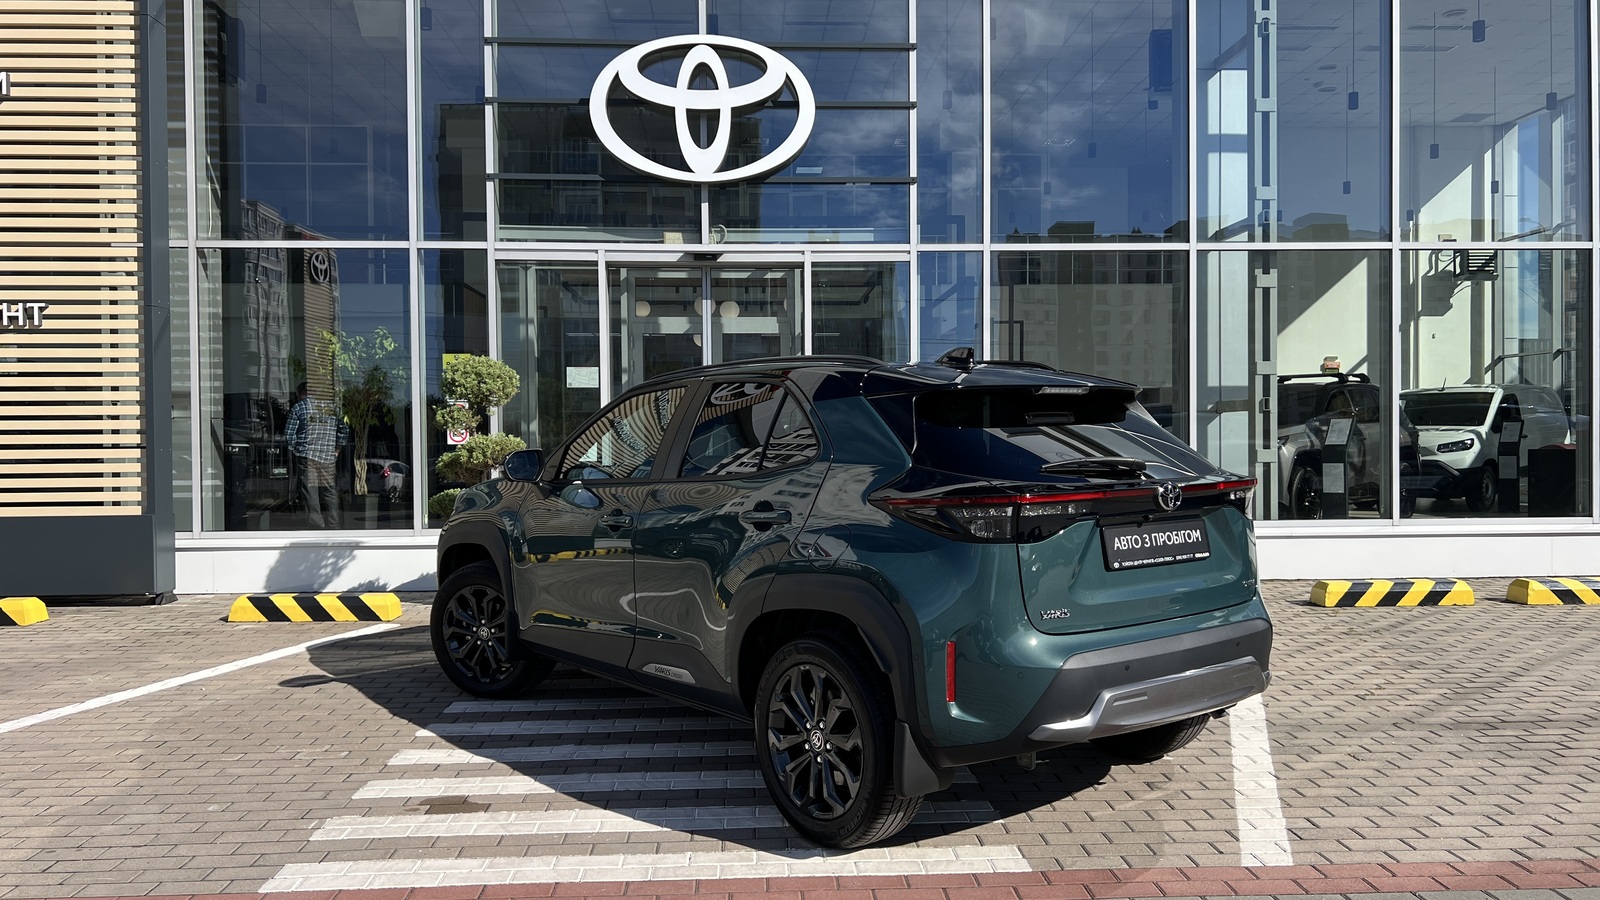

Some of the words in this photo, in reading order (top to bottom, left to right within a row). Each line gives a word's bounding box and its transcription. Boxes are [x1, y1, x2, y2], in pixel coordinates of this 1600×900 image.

[1114, 535, 1142, 550] АВТО
[1143, 534, 1151, 547] З
[1151, 529, 1202, 546] ПРОБІГОМ
[654, 665, 671, 676] YARIS
